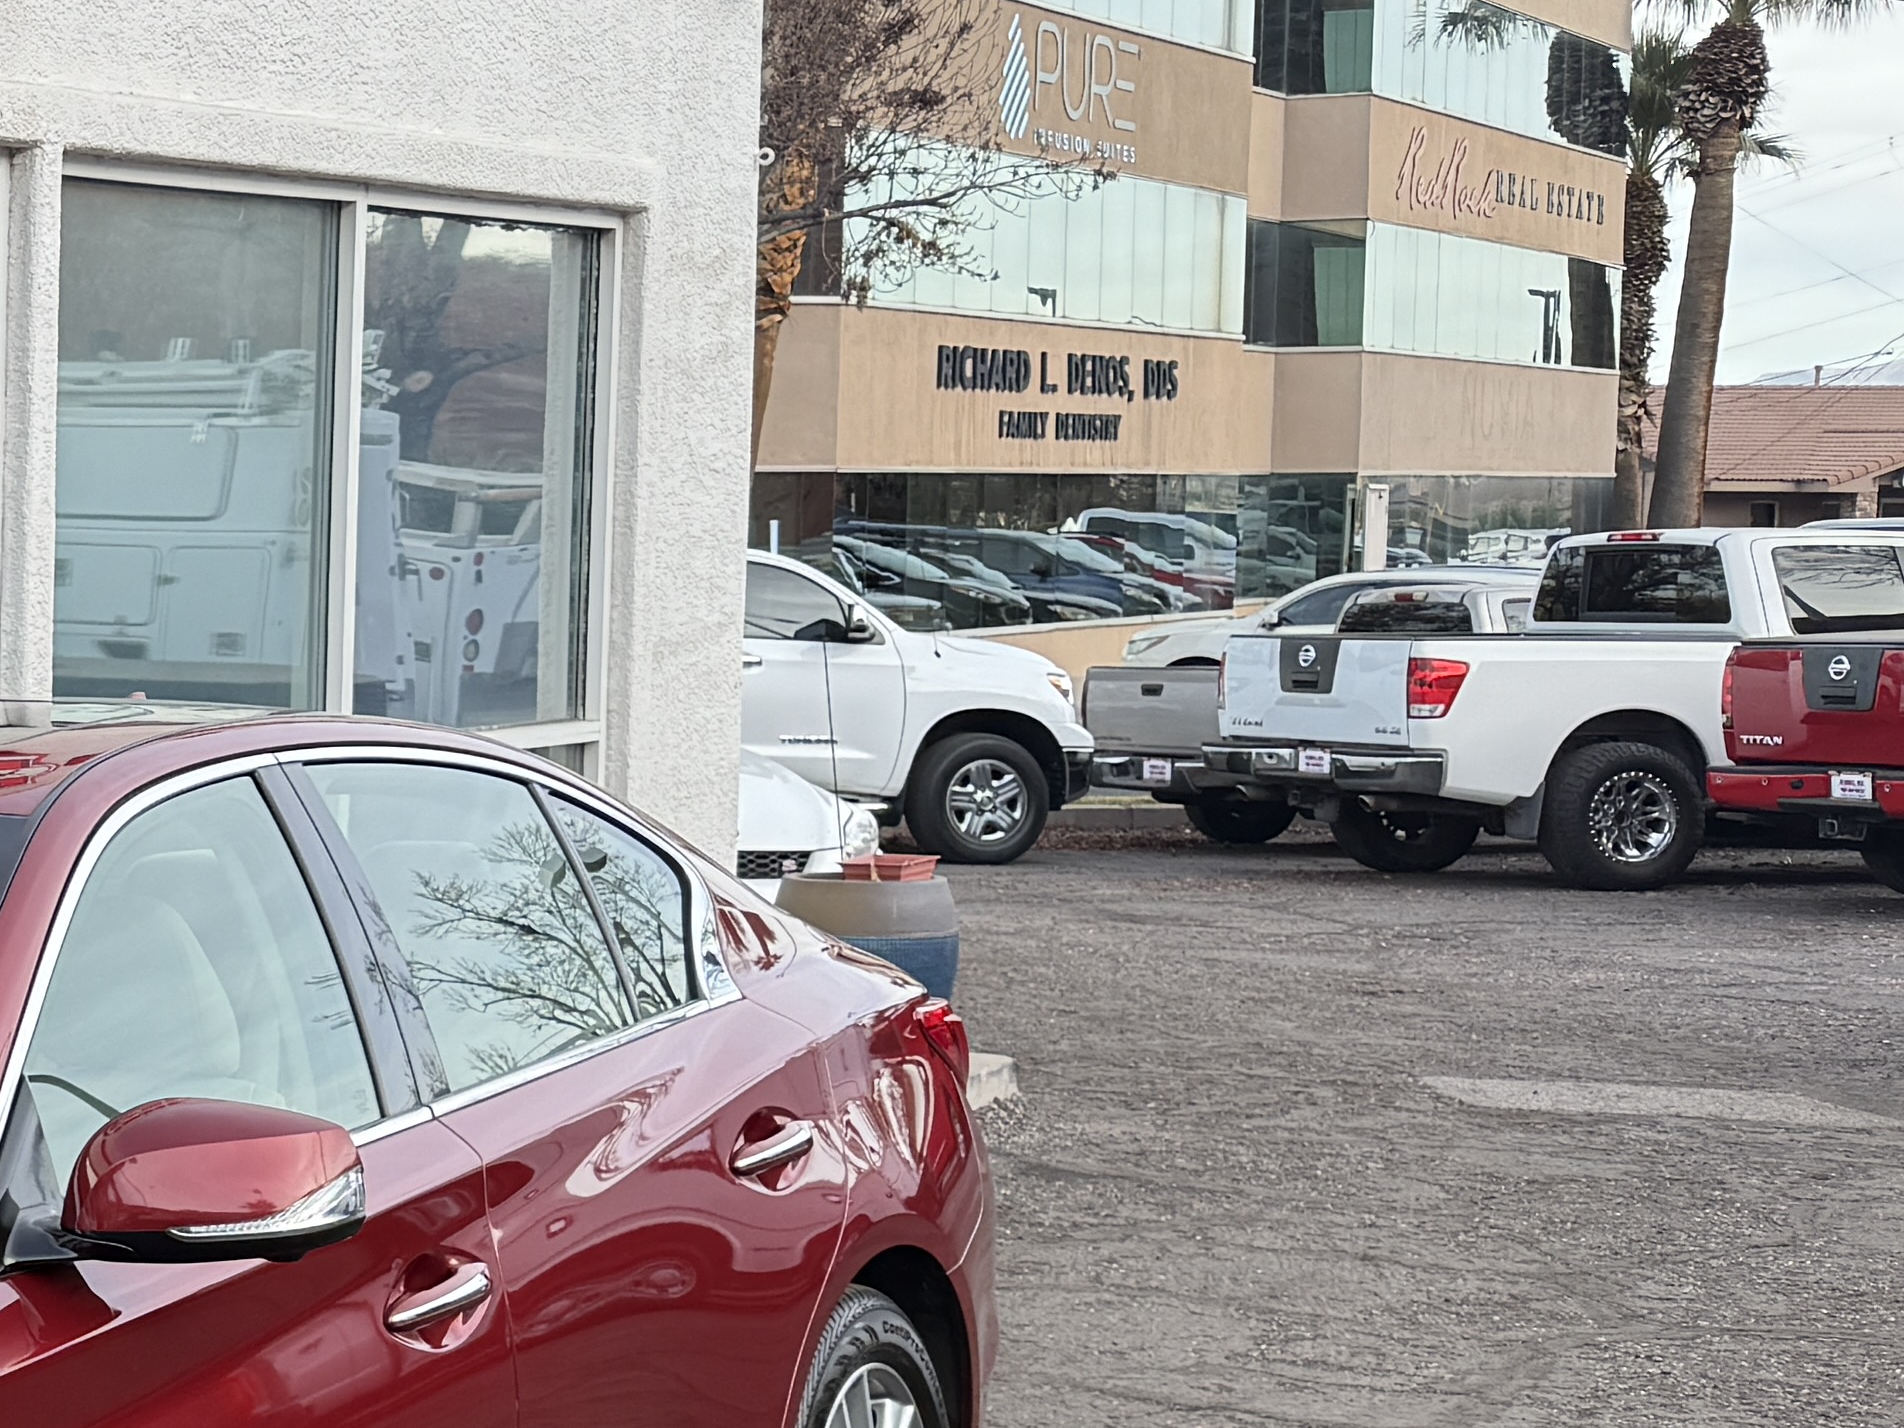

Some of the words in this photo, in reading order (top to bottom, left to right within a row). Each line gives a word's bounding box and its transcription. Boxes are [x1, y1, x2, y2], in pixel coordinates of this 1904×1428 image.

[1033, 20, 1140, 132] PURE
[1546, 180, 1605, 225] ESTATE
[936, 344, 1032, 394] RICHARD
[1142, 358, 1179, 402] DDS
[998, 409, 1049, 441] FAMILY
[1054, 412, 1122, 442] DENTISTRY
[1739, 734, 1783, 746] TITAN
